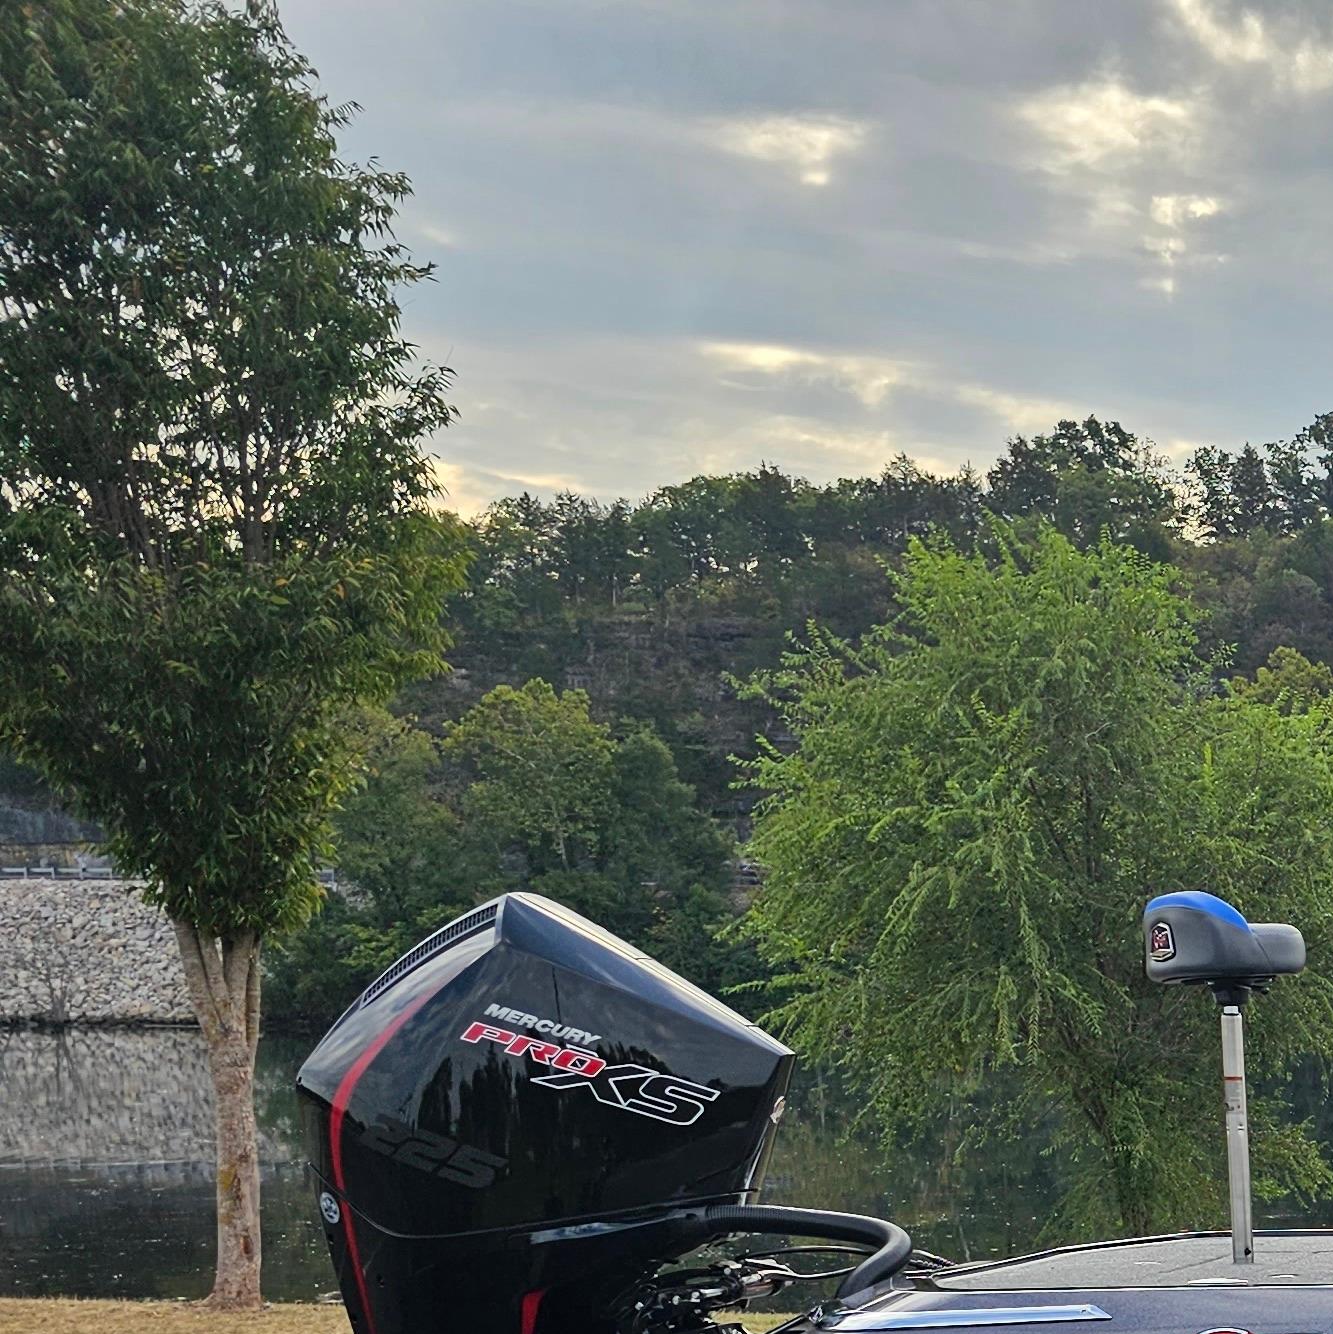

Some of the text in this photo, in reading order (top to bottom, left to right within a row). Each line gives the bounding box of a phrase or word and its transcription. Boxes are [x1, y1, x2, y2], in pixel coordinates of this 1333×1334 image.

[460, 1021, 607, 1078] PRO
[483, 1003, 602, 1046] MERCURY
[356, 1112, 510, 1188] 225
